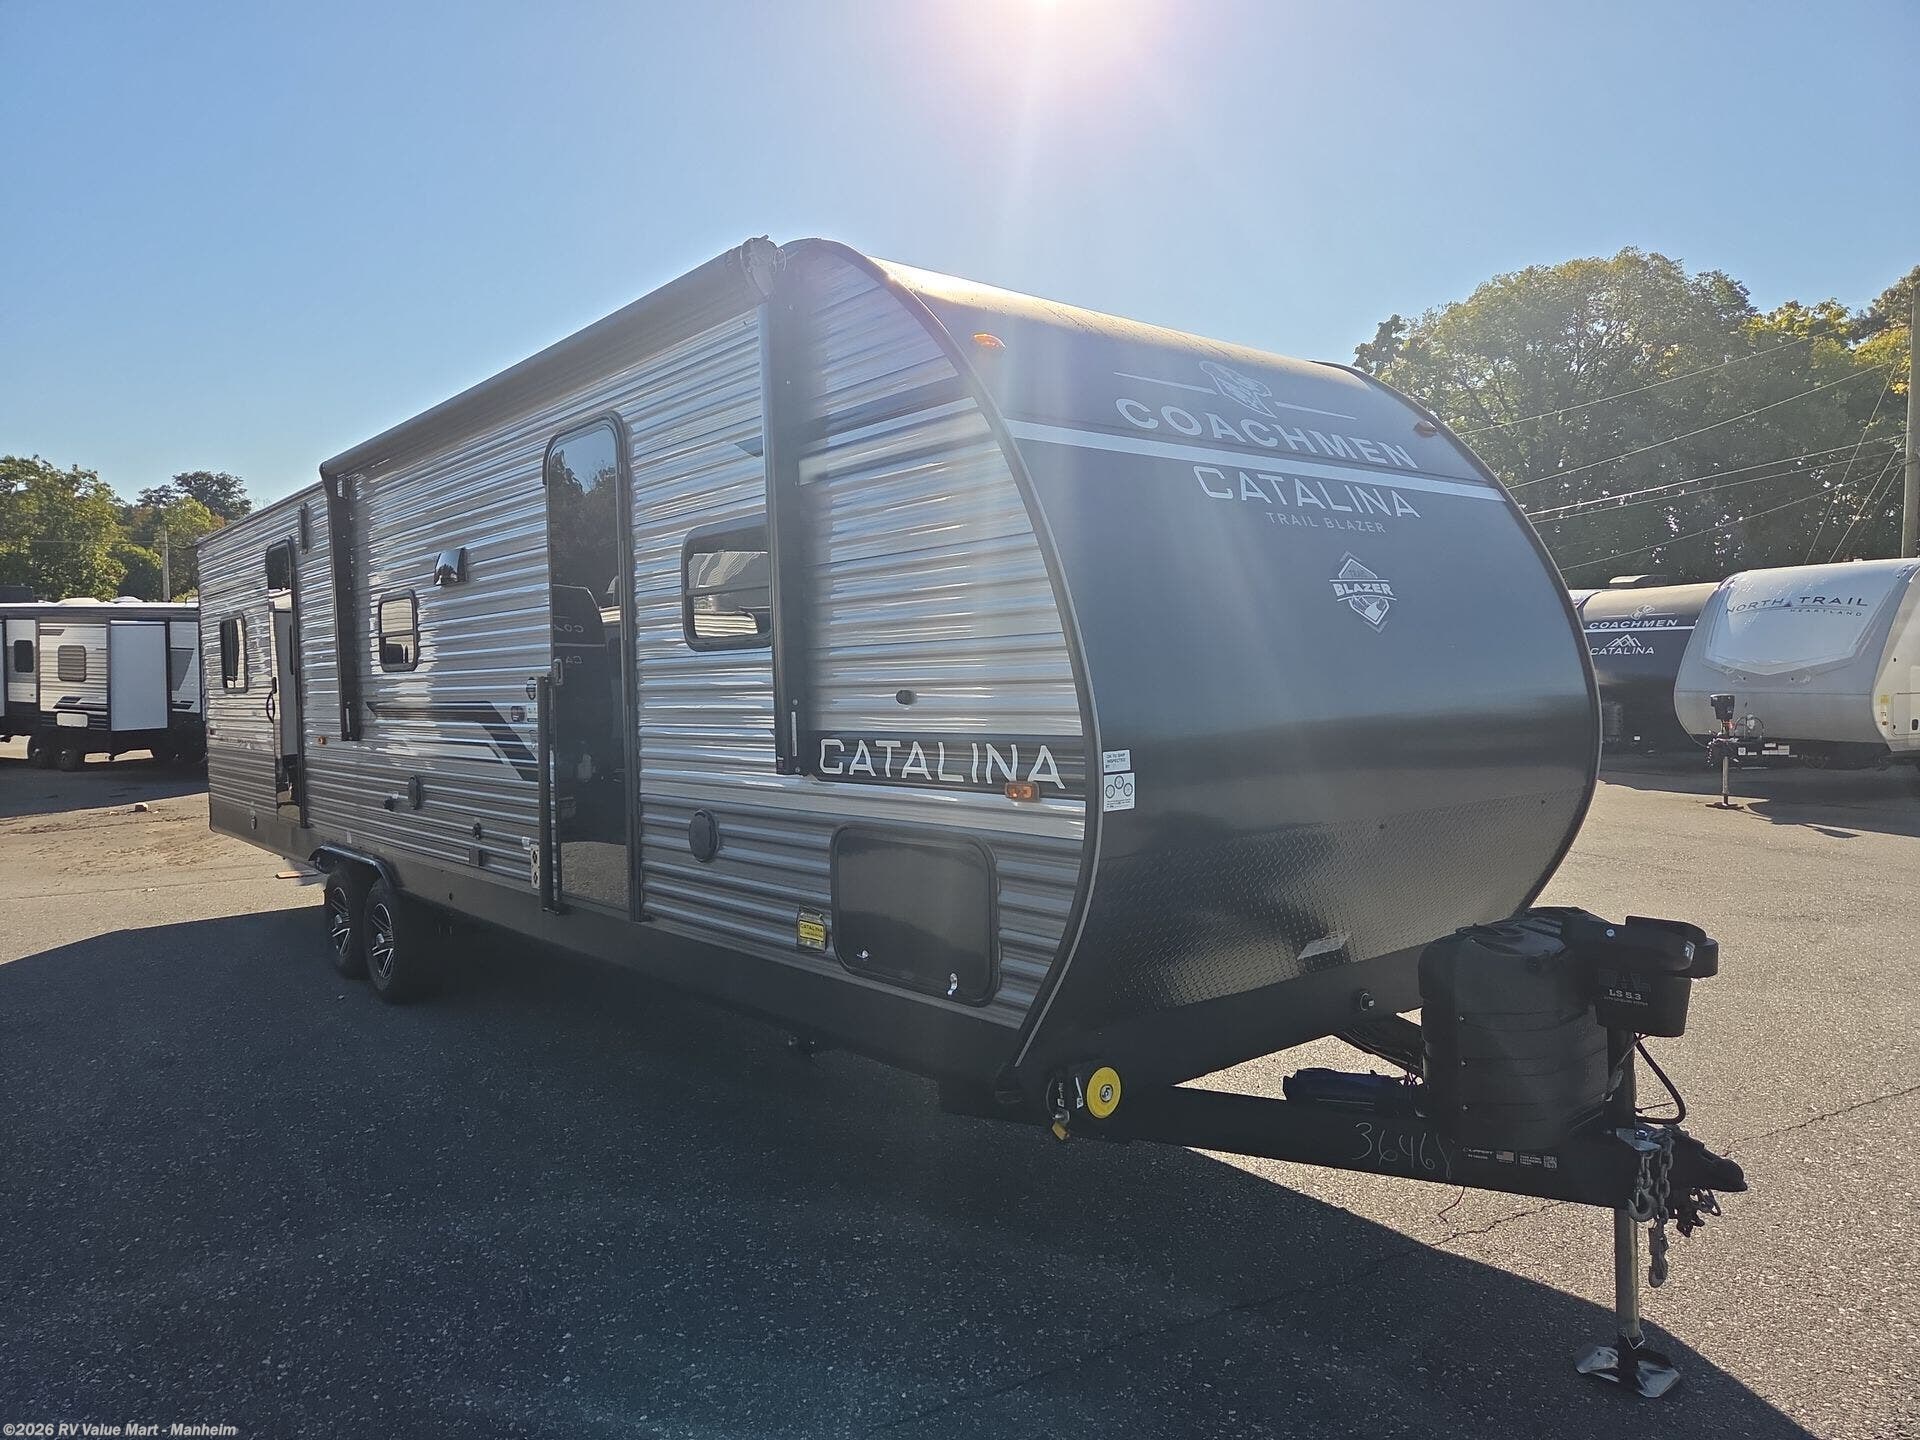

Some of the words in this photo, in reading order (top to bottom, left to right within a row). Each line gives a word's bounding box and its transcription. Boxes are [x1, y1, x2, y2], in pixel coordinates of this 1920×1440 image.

[1115, 398, 1419, 469] COACHMEN
[1193, 465, 1421, 518] CATALINA
[1266, 511, 1318, 528] TRAIL
[1326, 516, 1387, 533] BLAZER
[1332, 583, 1394, 597] BLAZER
[1725, 598, 1785, 614] NORTH
[1799, 596, 1869, 608] TRAIL
[1589, 618, 1678, 630] COACHMEN
[1590, 646, 1655, 656] CATALINA
[819, 738, 1065, 790] CATALINA
[1608, 988, 1623, 998] LS
